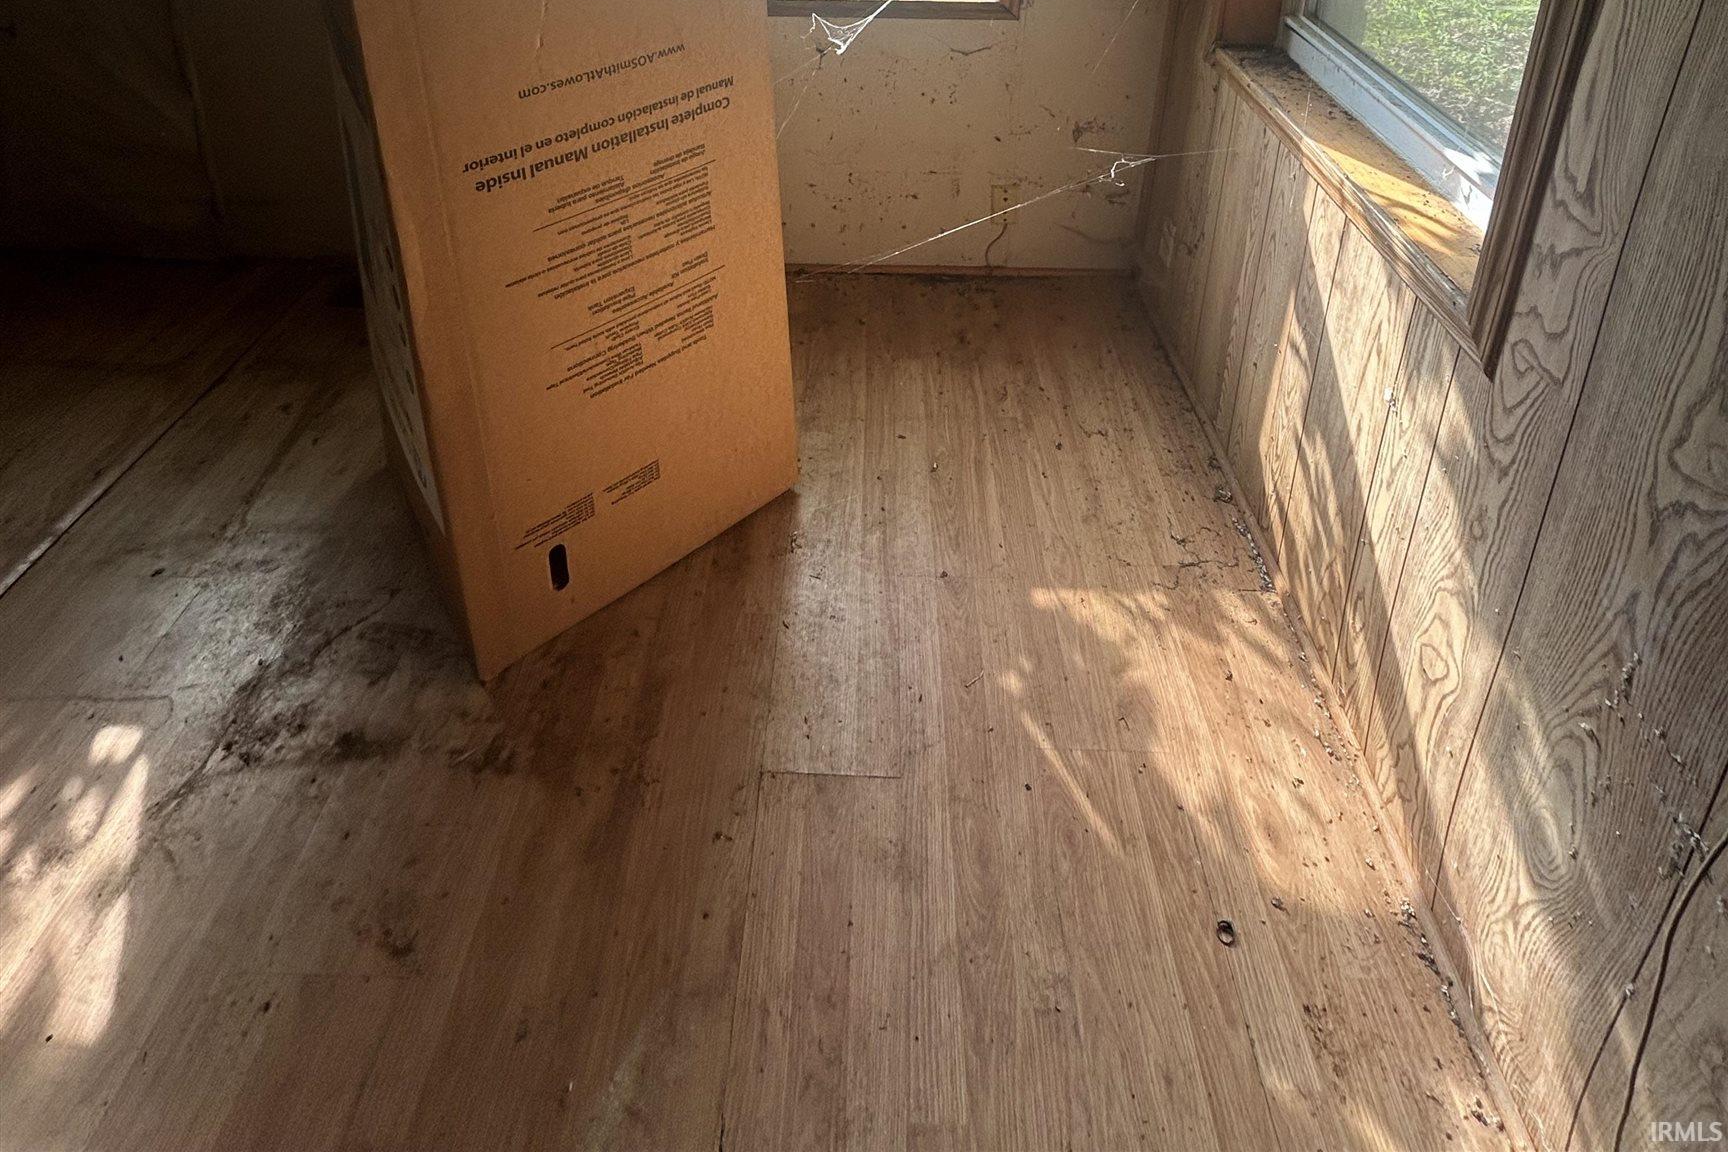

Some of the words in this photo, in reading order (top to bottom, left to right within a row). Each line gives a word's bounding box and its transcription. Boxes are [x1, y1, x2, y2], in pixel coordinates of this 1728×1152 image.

[518, 44, 684, 98] www.AOSmithAtLowes.com
[680, 89, 694, 102] de
[695, 75, 733, 98] Manual
[617, 95, 678, 122] instalación
[671, 96, 730, 124] Complete
[554, 116, 615, 143] completo
[591, 118, 669, 152] Installation
[519, 143, 532, 158] el
[535, 137, 552, 149] en
[462, 148, 517, 172] interior
[529, 146, 588, 177] Manual
[475, 167, 526, 192] Inside
